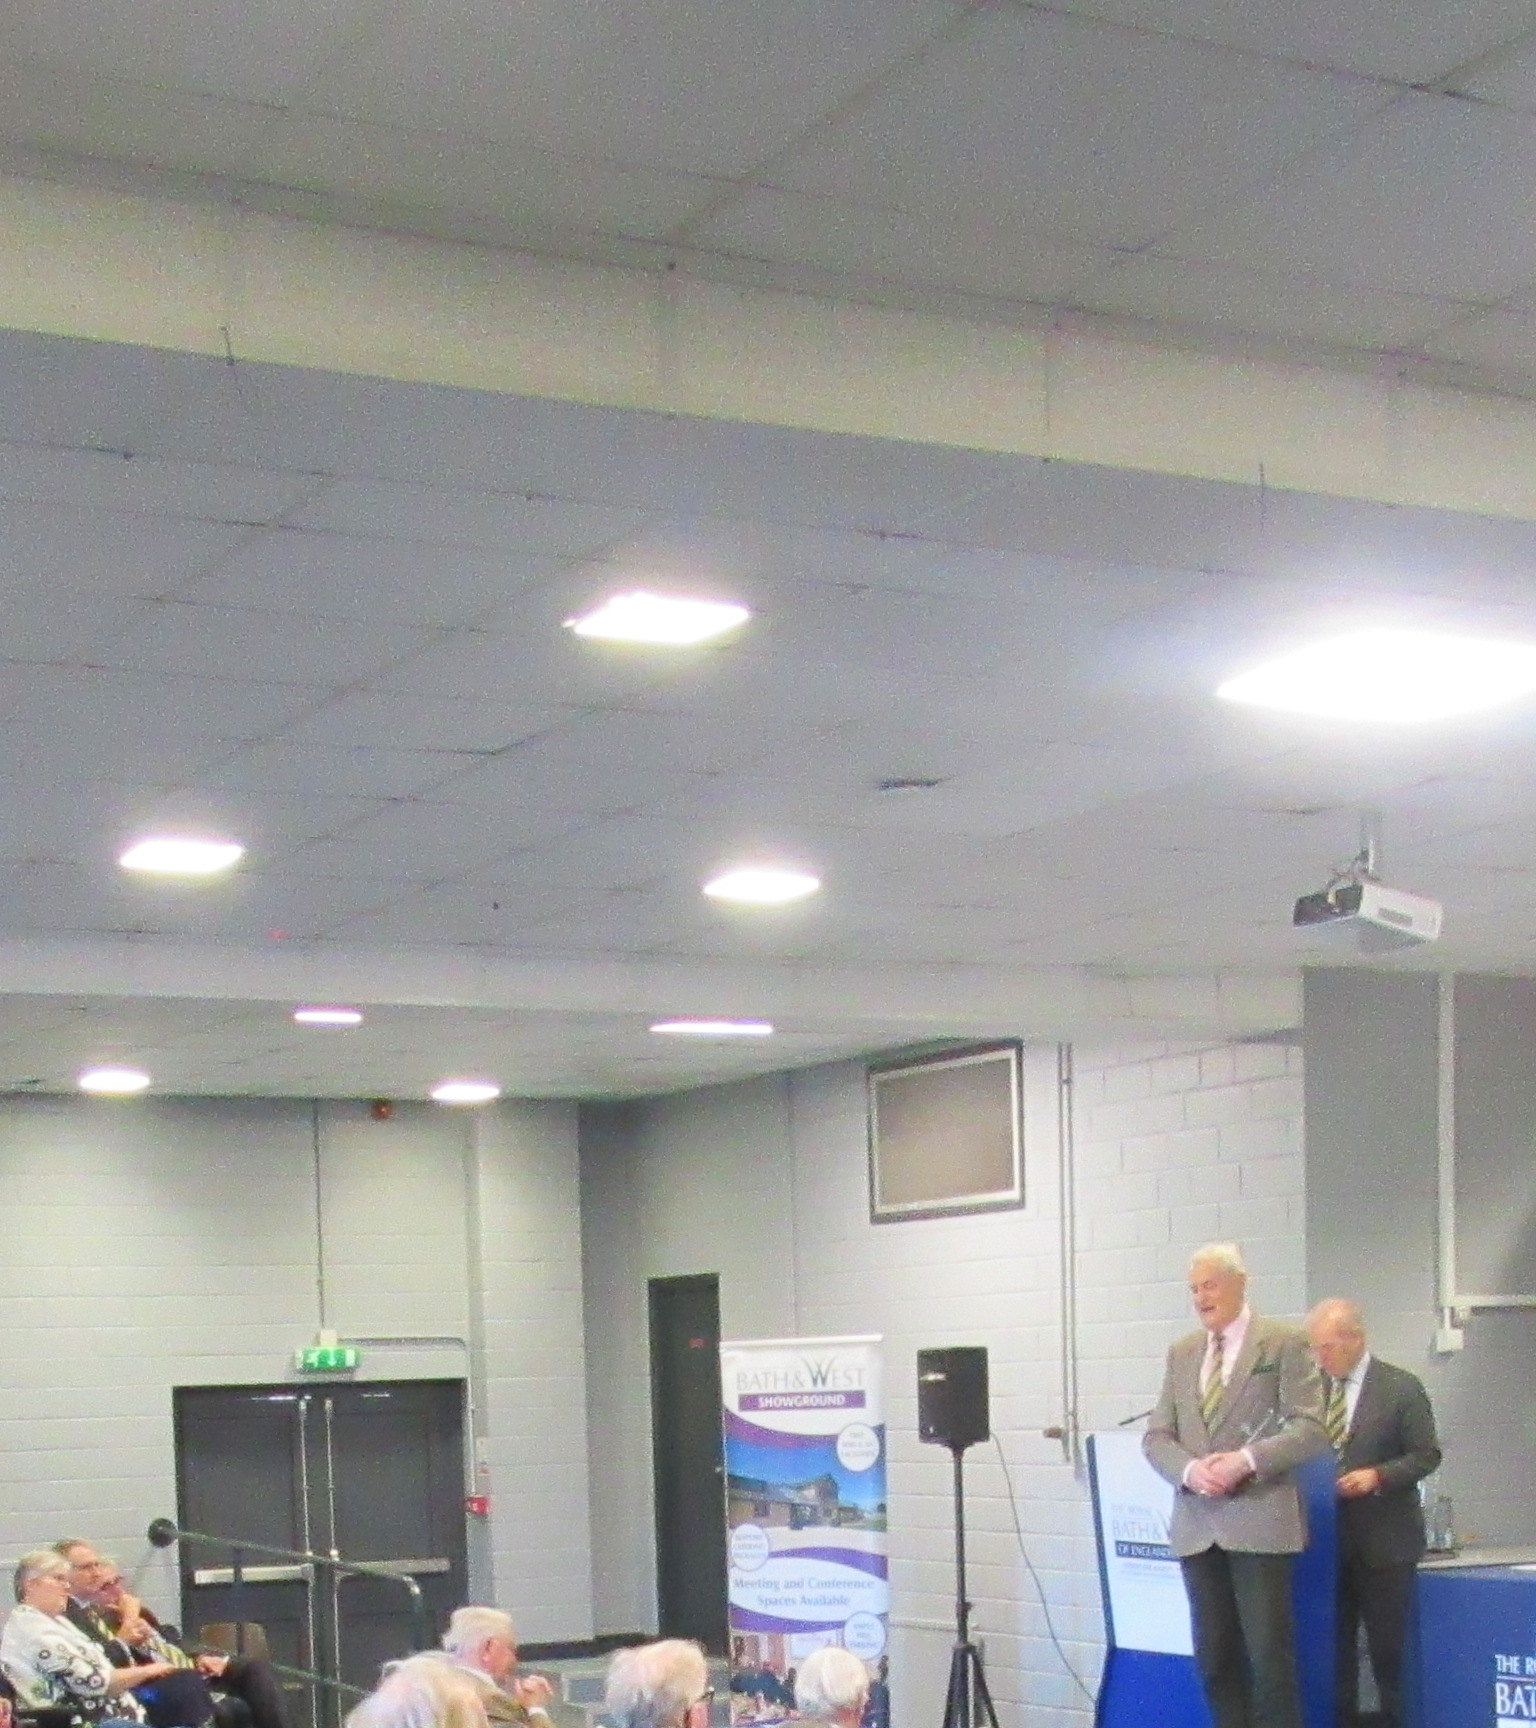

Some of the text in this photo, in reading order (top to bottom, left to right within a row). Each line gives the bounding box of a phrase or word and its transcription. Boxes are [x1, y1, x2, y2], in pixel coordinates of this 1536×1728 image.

[758, 1394, 846, 1409] SHOWGROUND
[734, 1577, 875, 1592] Meeting and Conference
[758, 1594, 850, 1608] Spaces Available
[1495, 1654, 1520, 1674] THE
